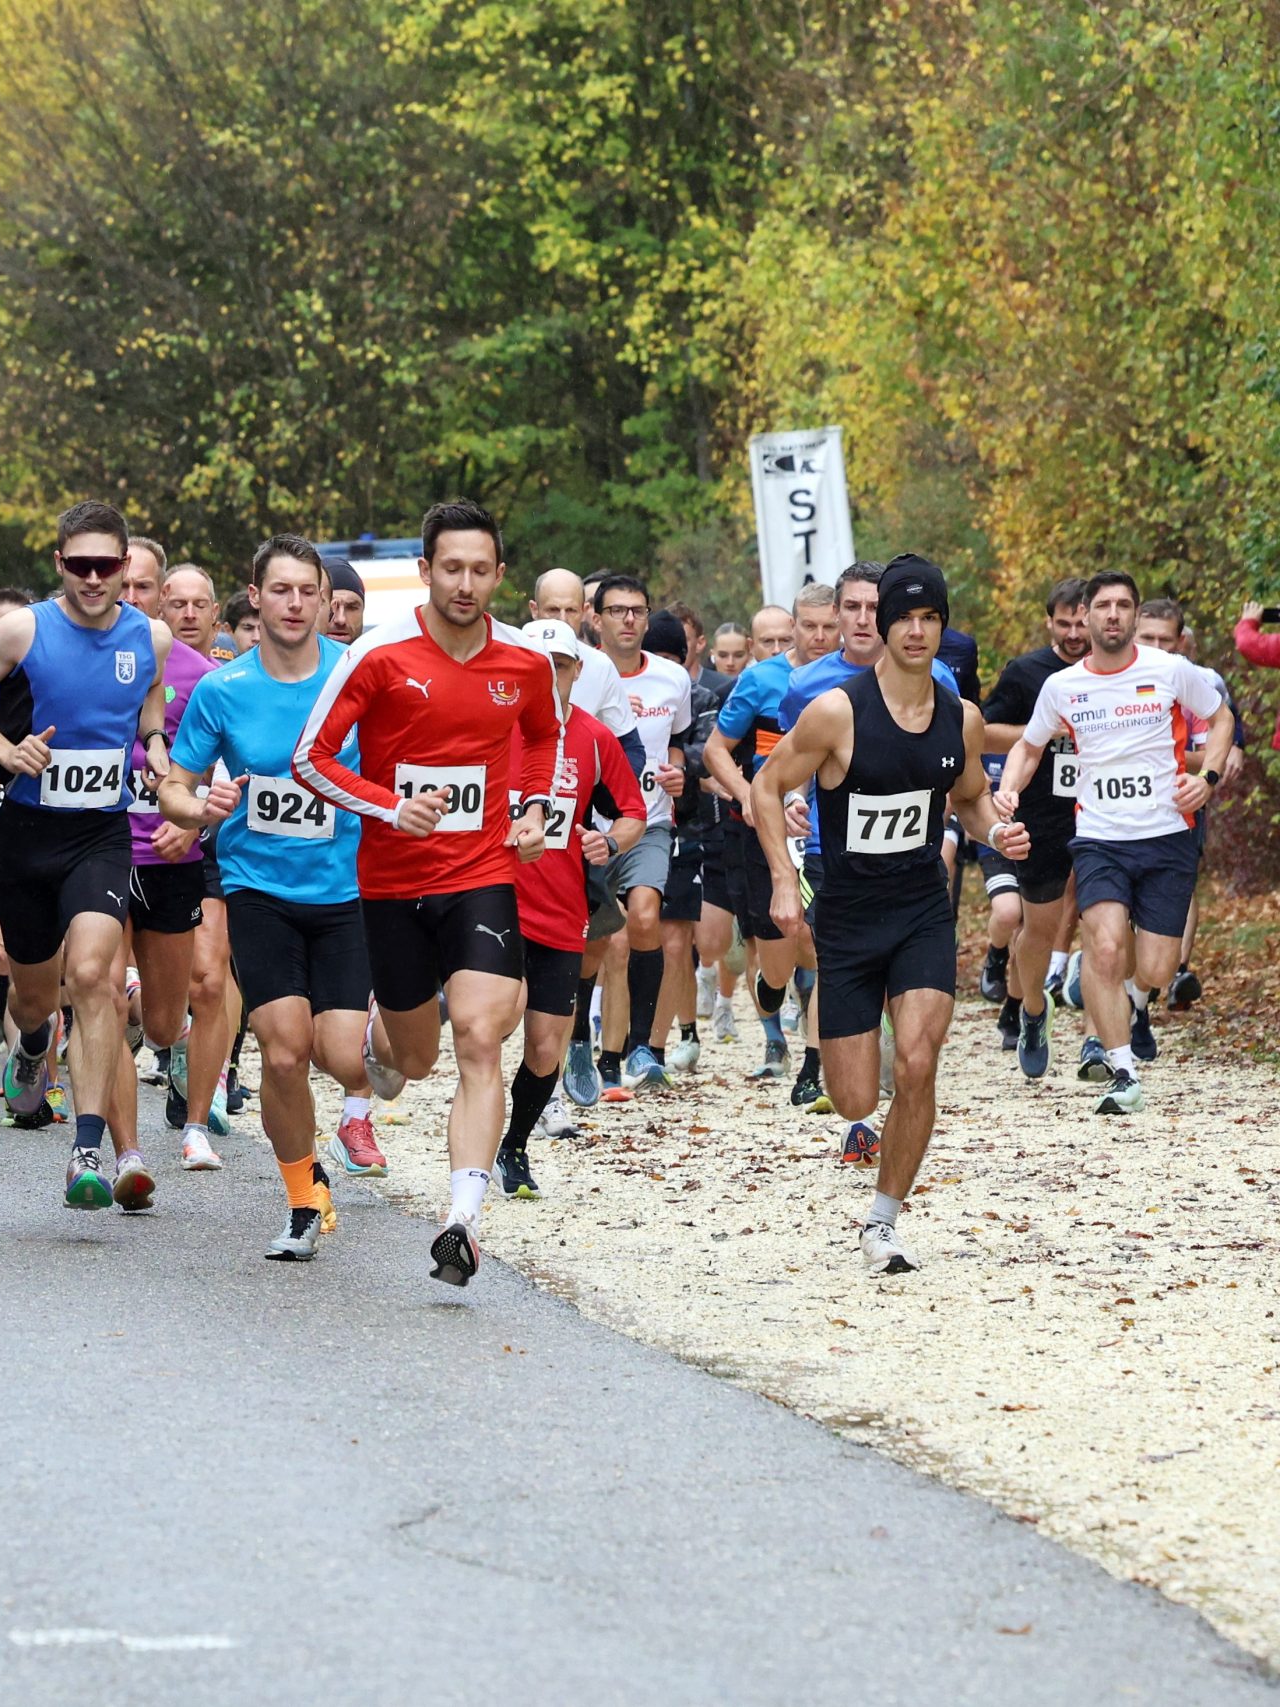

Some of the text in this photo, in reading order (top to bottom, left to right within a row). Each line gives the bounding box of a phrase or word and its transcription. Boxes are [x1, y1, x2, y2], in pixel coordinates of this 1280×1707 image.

[1115, 703, 1162, 717] OSRAM
[46, 764, 120, 793] 1024
[1060, 764, 1080, 787] 8
[1093, 775, 1152, 800] 1053
[257, 790, 327, 827] 924
[857, 804, 922, 840] 772
